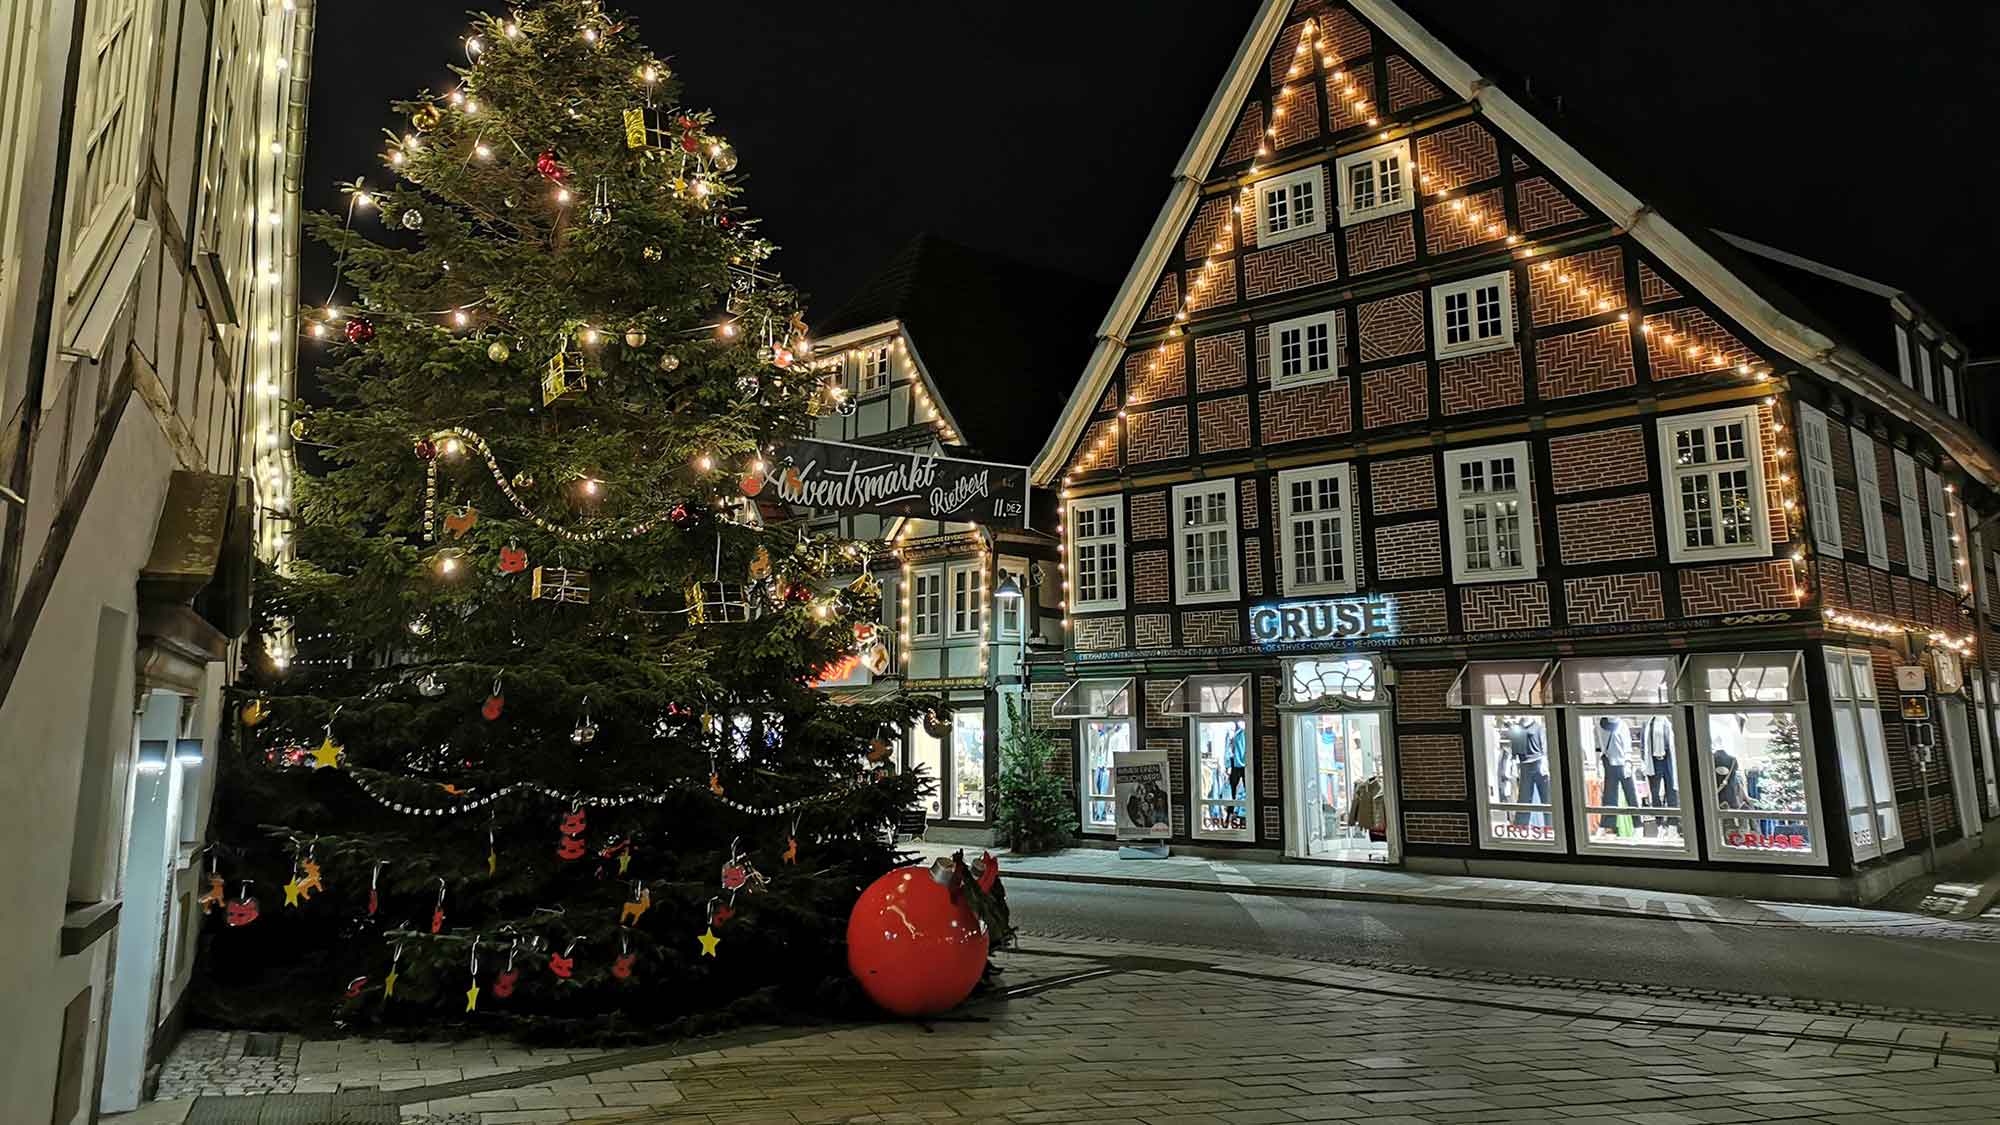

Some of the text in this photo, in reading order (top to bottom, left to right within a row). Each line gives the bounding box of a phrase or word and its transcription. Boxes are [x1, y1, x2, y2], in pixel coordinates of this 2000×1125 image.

[930, 469, 988, 516] Rietberg
[1253, 602, 1389, 641] CRUSE
[1203, 816, 1246, 829] CRUSE
[1494, 823, 1553, 839] CRUSE
[1727, 832, 1805, 848] CRUSE
